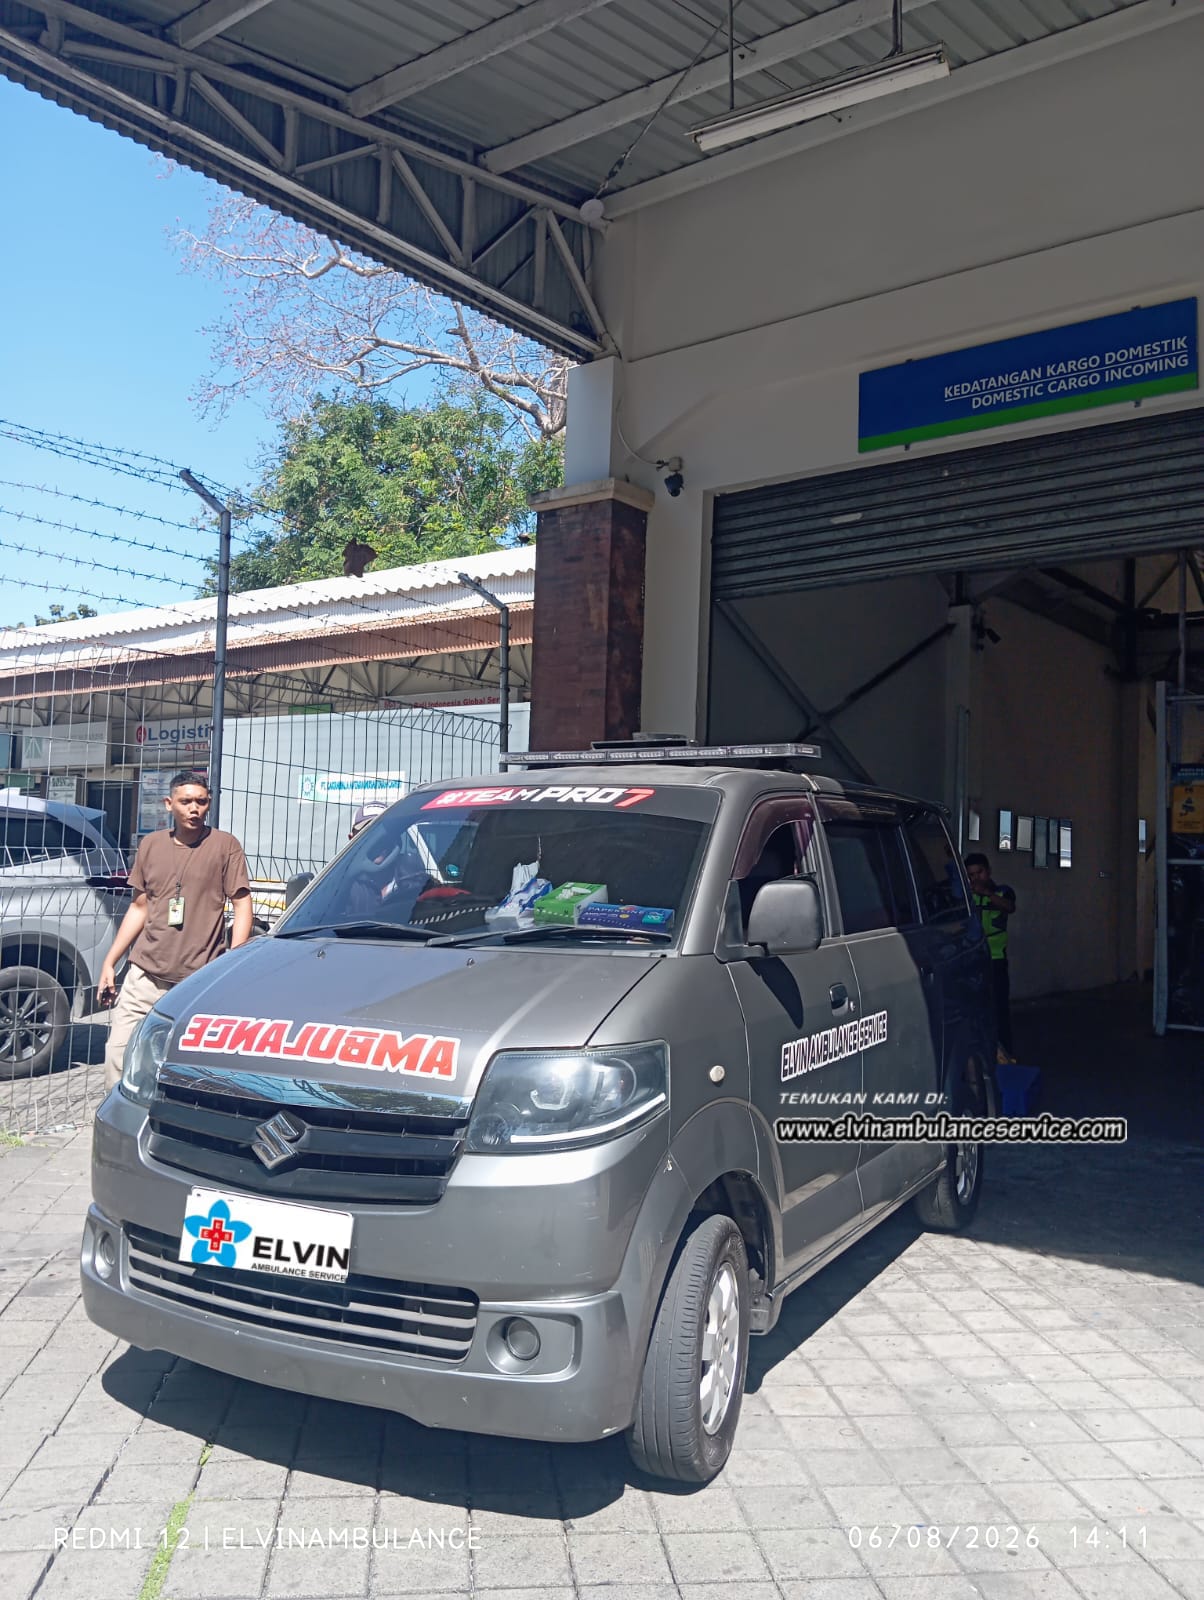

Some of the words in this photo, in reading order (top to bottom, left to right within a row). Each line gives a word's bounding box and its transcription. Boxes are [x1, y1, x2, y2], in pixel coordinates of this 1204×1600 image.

[944, 368, 1042, 399] KEDATANGAN
[1046, 355, 1100, 377] KARGO
[1105, 336, 1188, 364] DOMESTIK
[972, 383, 1044, 409] DOMESTIC
[1047, 373, 1101, 394] CARGO
[1105, 354, 1189, 382] INCOMING
[487, 696, 501, 704] Ser
[148, 723, 210, 743] Logisti
[781, 1038, 808, 1081] ELVIN
[809, 1021, 859, 1071] AMBULANCE
[859, 1011, 887, 1051] SERVICE
